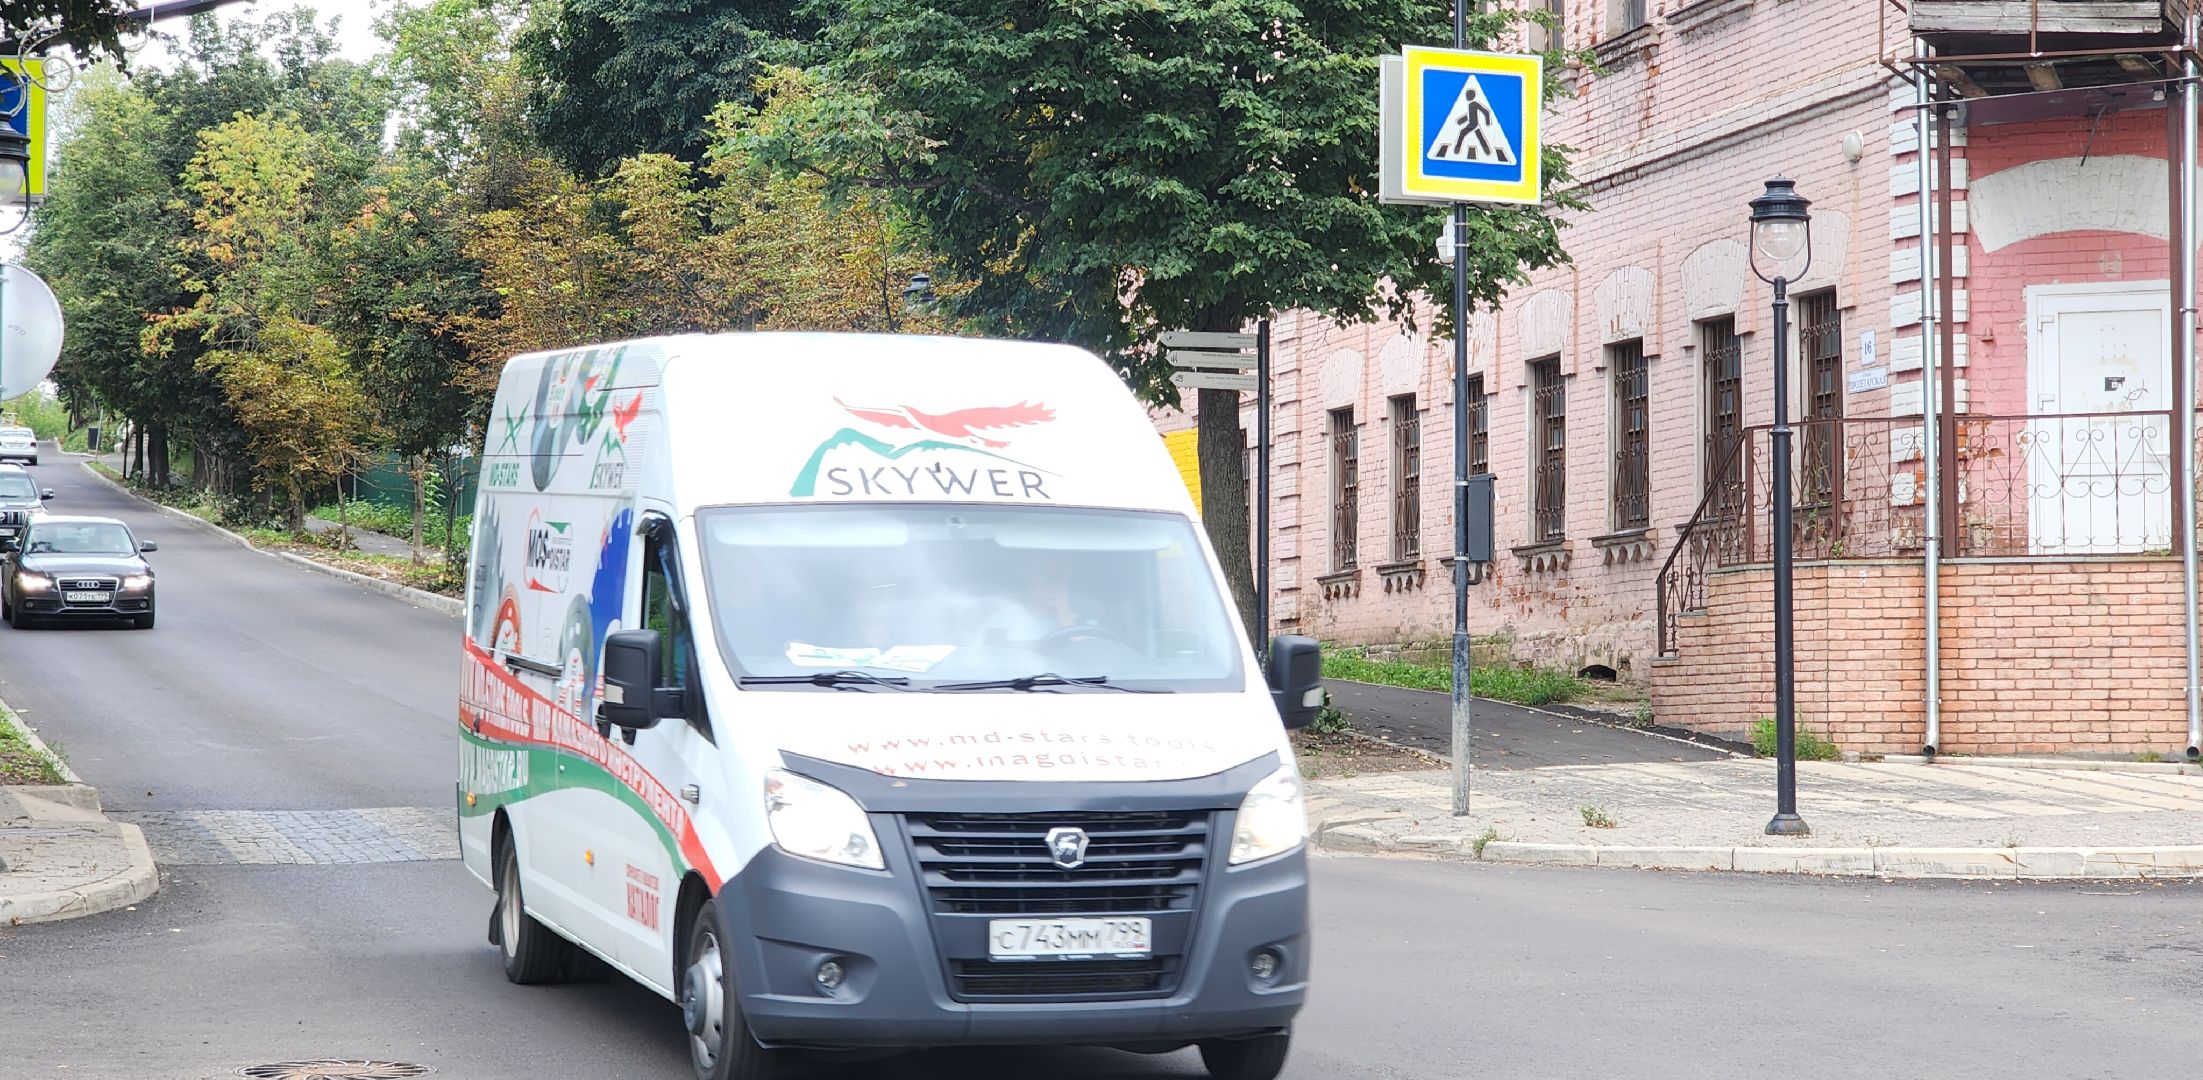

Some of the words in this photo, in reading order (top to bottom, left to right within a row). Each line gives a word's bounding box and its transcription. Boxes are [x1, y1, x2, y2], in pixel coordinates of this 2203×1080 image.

[1864, 341, 1872, 355] 16
[827, 466, 1052, 499] SKYWER
[606, 742, 686, 837] ИНСТРУМЕНТА
